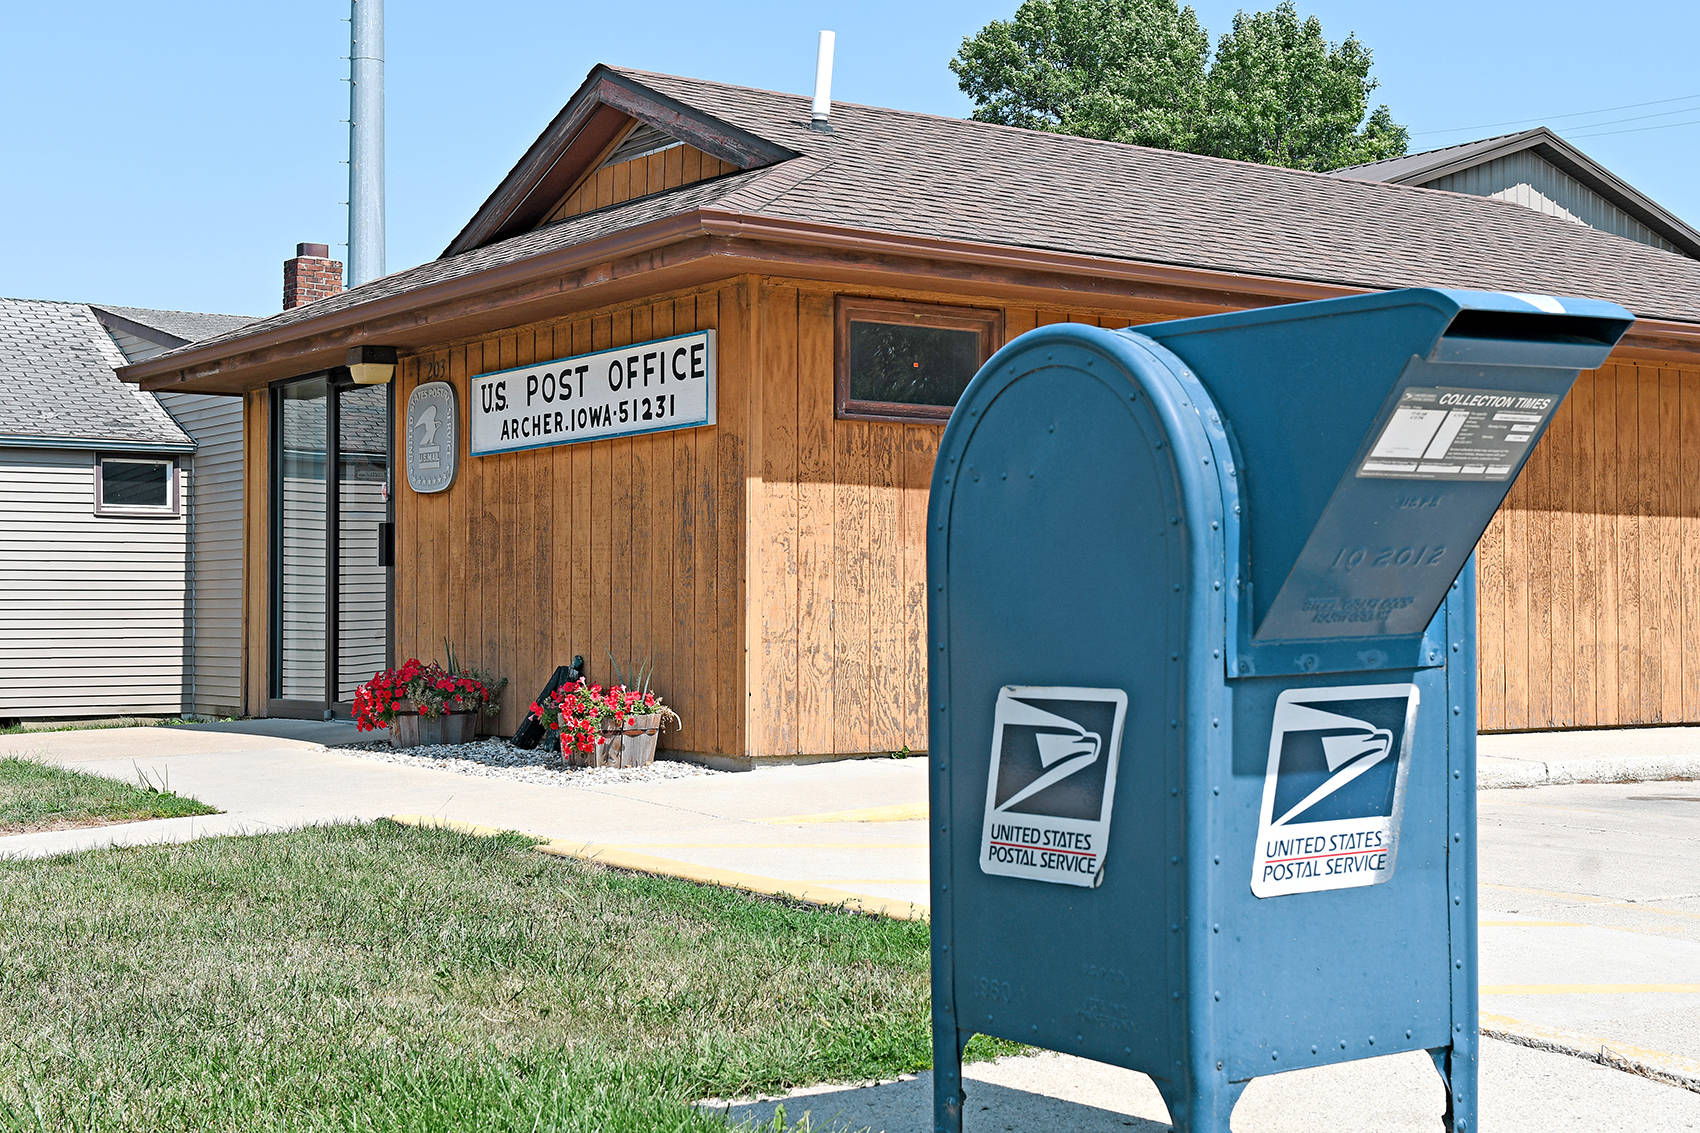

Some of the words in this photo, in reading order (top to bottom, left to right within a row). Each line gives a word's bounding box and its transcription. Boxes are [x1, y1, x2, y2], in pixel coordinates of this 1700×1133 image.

[426, 359, 446, 379] 203
[481, 381, 508, 413] U.S.
[527, 365, 589, 406] POST
[608, 343, 705, 392] OFFICE
[1439, 393, 1516, 409] COLLECTION
[1515, 397, 1551, 410] TIMES
[1372, 544, 1448, 569] 2012
[991, 823, 1041, 845] UNITED
[1043, 829, 1092, 851] STATES
[1266, 836, 1326, 859] UNITED
[1329, 830, 1383, 852] STATES
[988, 845, 1037, 867] POSTAL
[1040, 852, 1097, 875] SERVICE
[1262, 860, 1321, 882] POSTAL
[1324, 853, 1388, 876] SERVICE
